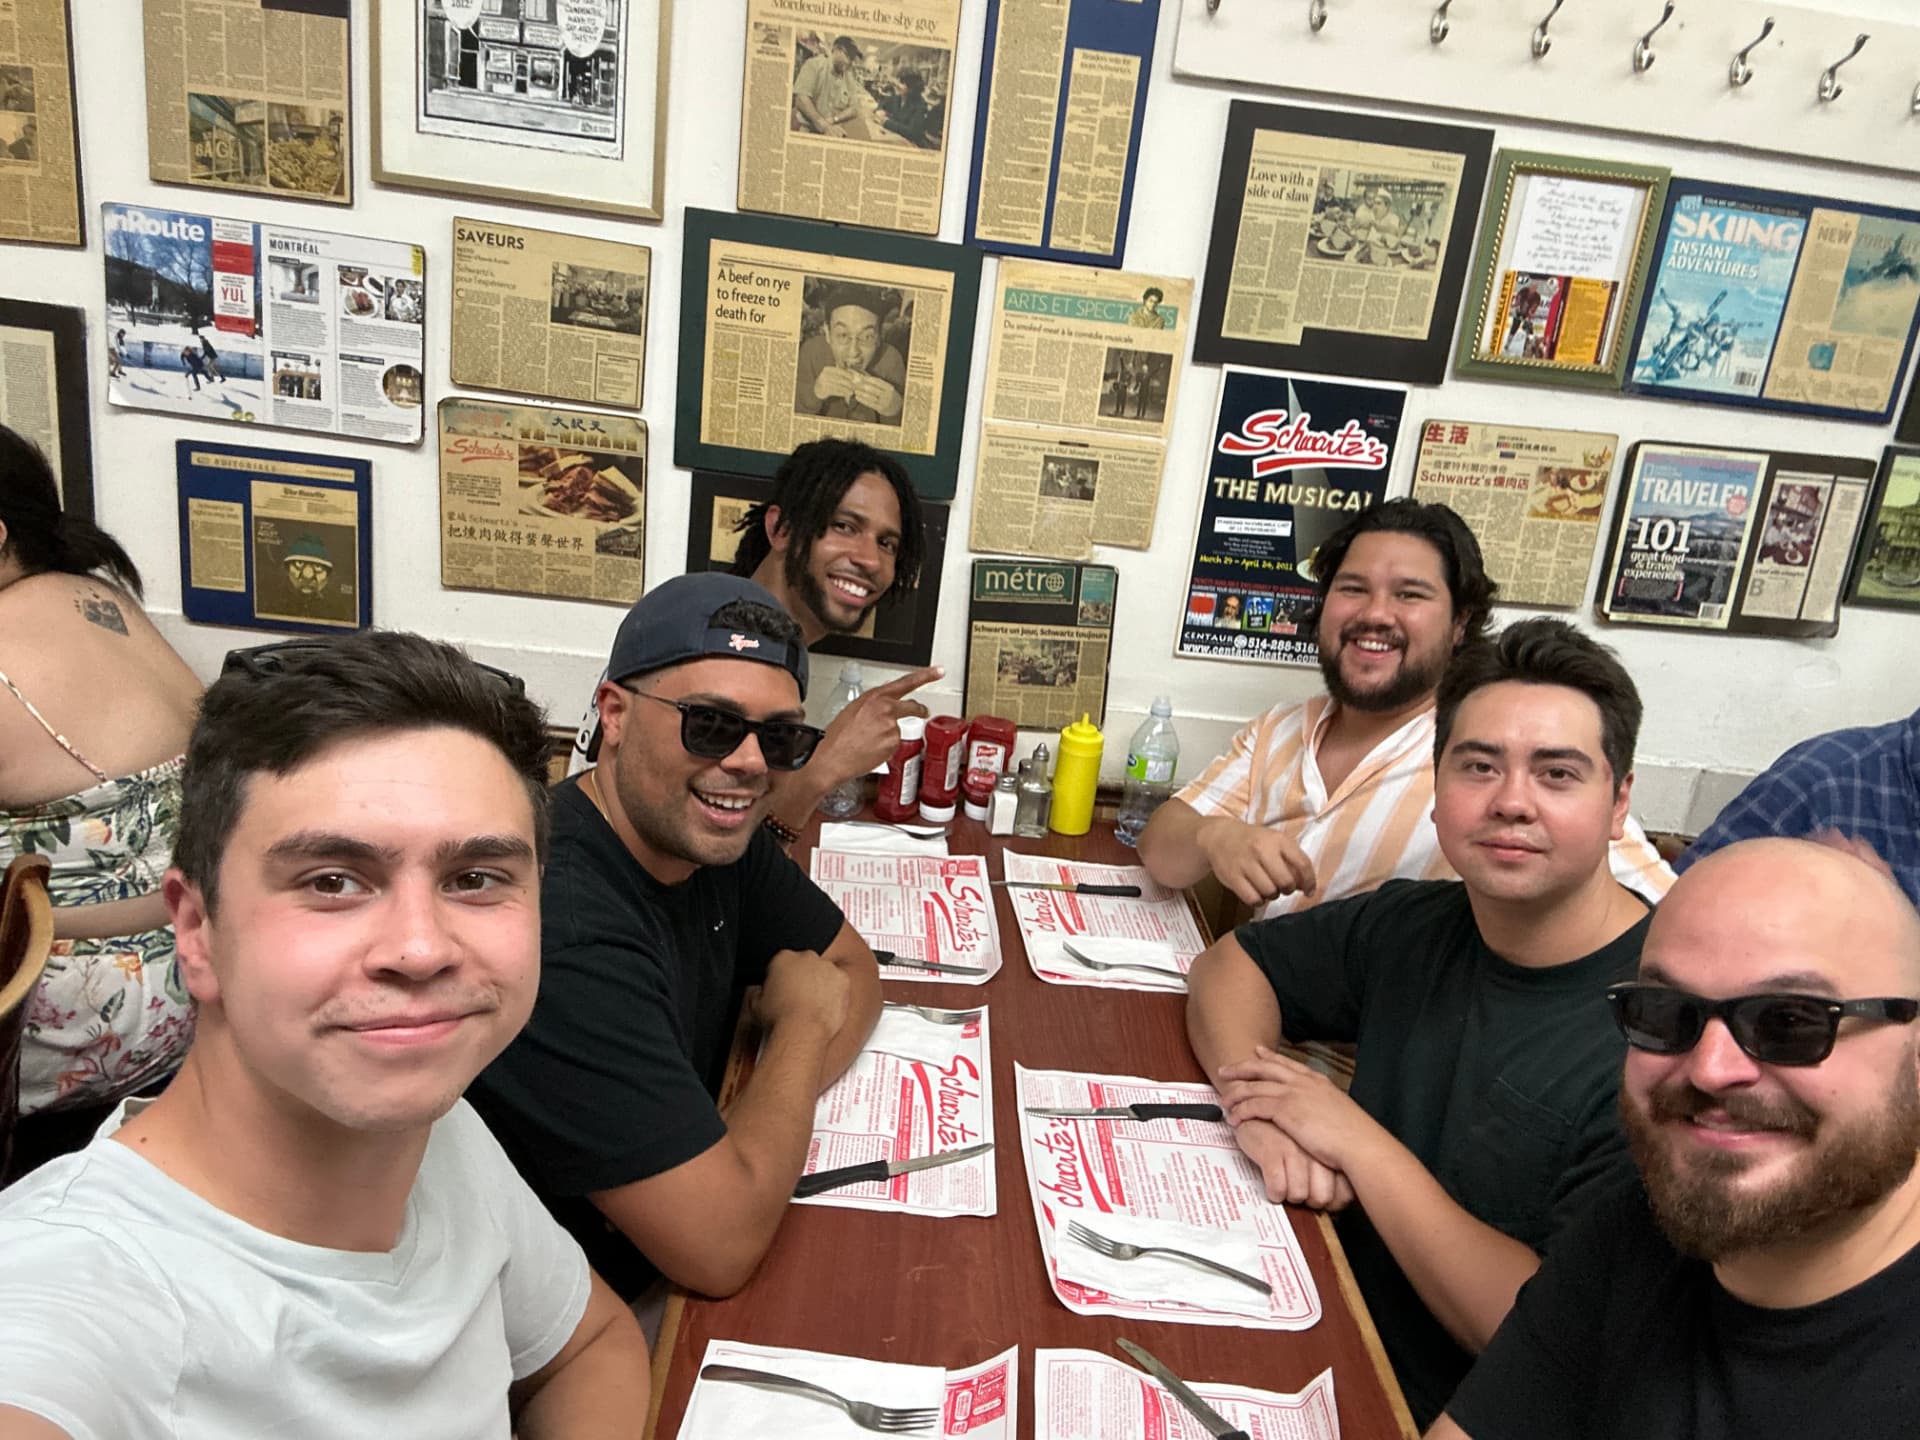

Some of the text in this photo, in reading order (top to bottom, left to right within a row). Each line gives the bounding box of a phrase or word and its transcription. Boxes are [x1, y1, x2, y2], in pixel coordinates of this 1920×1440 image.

[873, 9, 892, 24] the
[894, 13, 912, 29] shy
[915, 18, 937, 33] guy
[1250, 166, 1314, 187] Love with a
[1247, 184, 1310, 203] side of slaw
[457, 228, 525, 250] SAVEURS
[1672, 211, 1800, 251] SKIING
[269, 239, 320, 255] MONTRÉAL
[1672, 240, 1732, 260] INSTANT
[1667, 255, 1759, 278] ADVENTURES
[717, 268, 791, 292] A beef on rye
[222, 287, 246, 303] YUL
[716, 288, 781, 308] to freeze to
[1007, 291, 1049, 311] ARTS
[1051, 297, 1072, 313] ET
[715, 304, 766, 324] death for
[1004, 319, 1016, 330] Du
[1219, 411, 1387, 470] Schwartz's
[1425, 424, 1469, 445] 生活
[1421, 470, 1491, 486] Schwartz's
[1214, 477, 1259, 501] THE
[1632, 517, 1691, 553] 101
[1200, 554, 1221, 564] March
[1241, 557, 1259, 571] April
[1630, 552, 1685, 563] great food
[1646, 560, 1676, 571] travel
[985, 566, 1065, 592] métro
[1624, 568, 1685, 580] experiences
[1749, 577, 1765, 596] B
[973, 624, 1008, 634] Schwartz
[1040, 628, 1074, 638] Schwartz
[1075, 630, 1108, 640] toujours
[1184, 631, 1233, 643] CENTAUR
